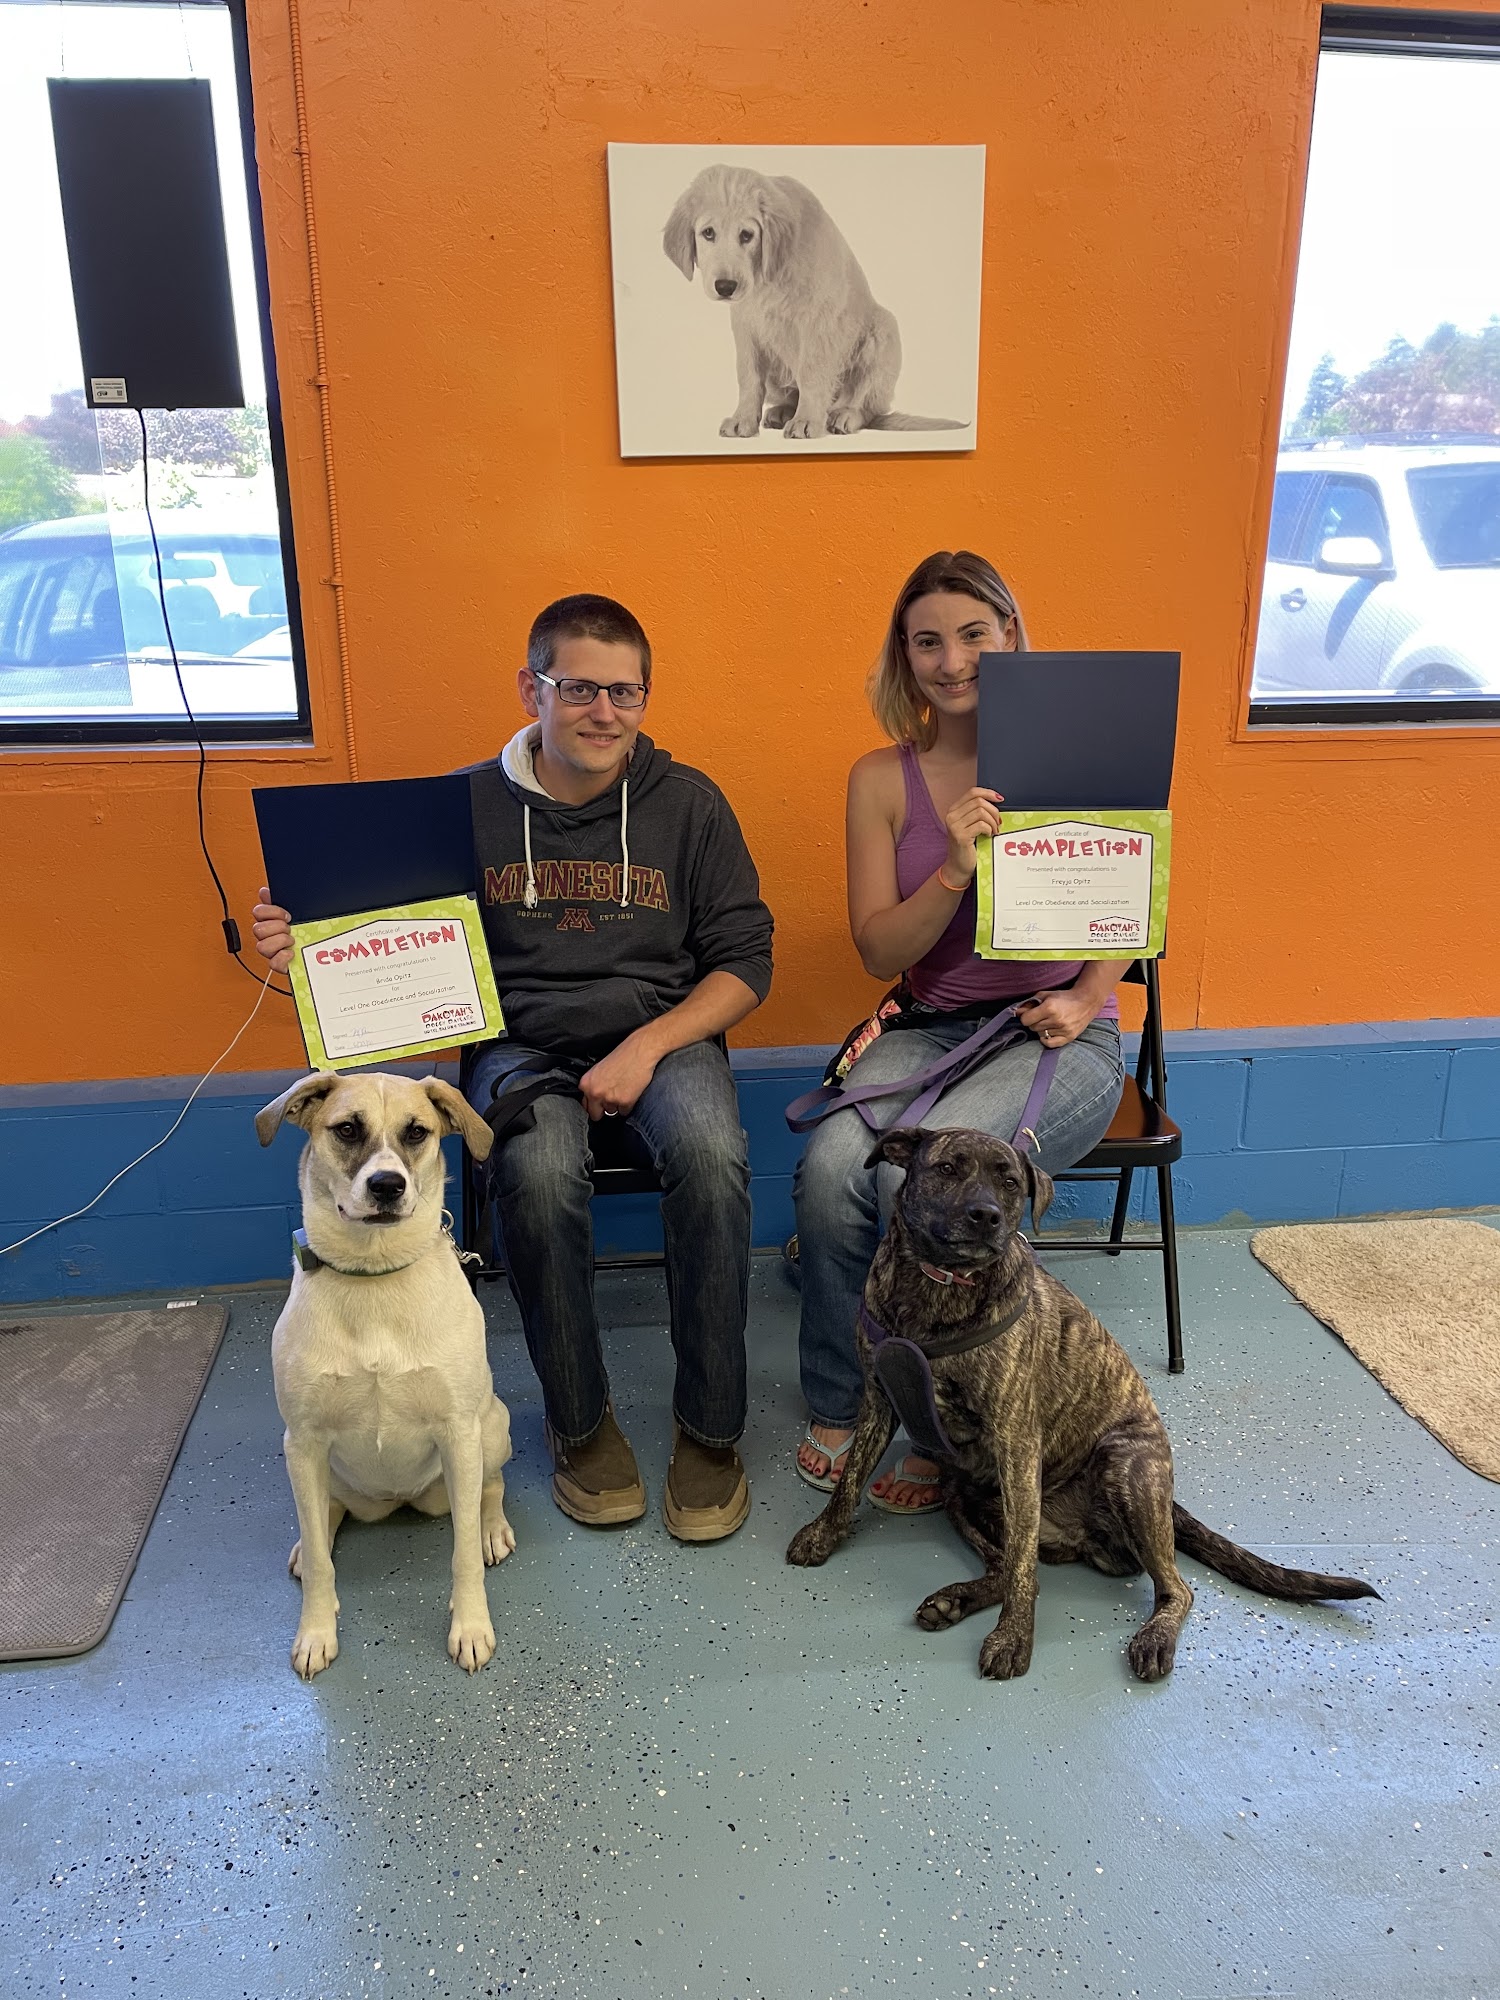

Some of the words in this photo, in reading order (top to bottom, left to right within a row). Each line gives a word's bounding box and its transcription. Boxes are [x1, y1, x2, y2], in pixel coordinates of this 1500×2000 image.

[484, 860, 670, 912] MINNESOTA
[516, 910, 553, 918] GOPHERS
[556, 907, 595, 932] M
[600, 913, 614, 921] EST
[365, 927, 394, 938] Certificate
[1089, 923, 1140, 931] DAKOTAH'S
[345, 967, 373, 977] Presented
[373, 965, 386, 973] with
[386, 957, 430, 969] congratulations
[393, 973, 411, 981] Opitz
[340, 1003, 356, 1012] Level
[371, 996, 404, 1006] Obedience
[404, 991, 416, 1000] and
[417, 985, 456, 998] Socialization
[421, 1006, 474, 1023] DAKOTAH'S
